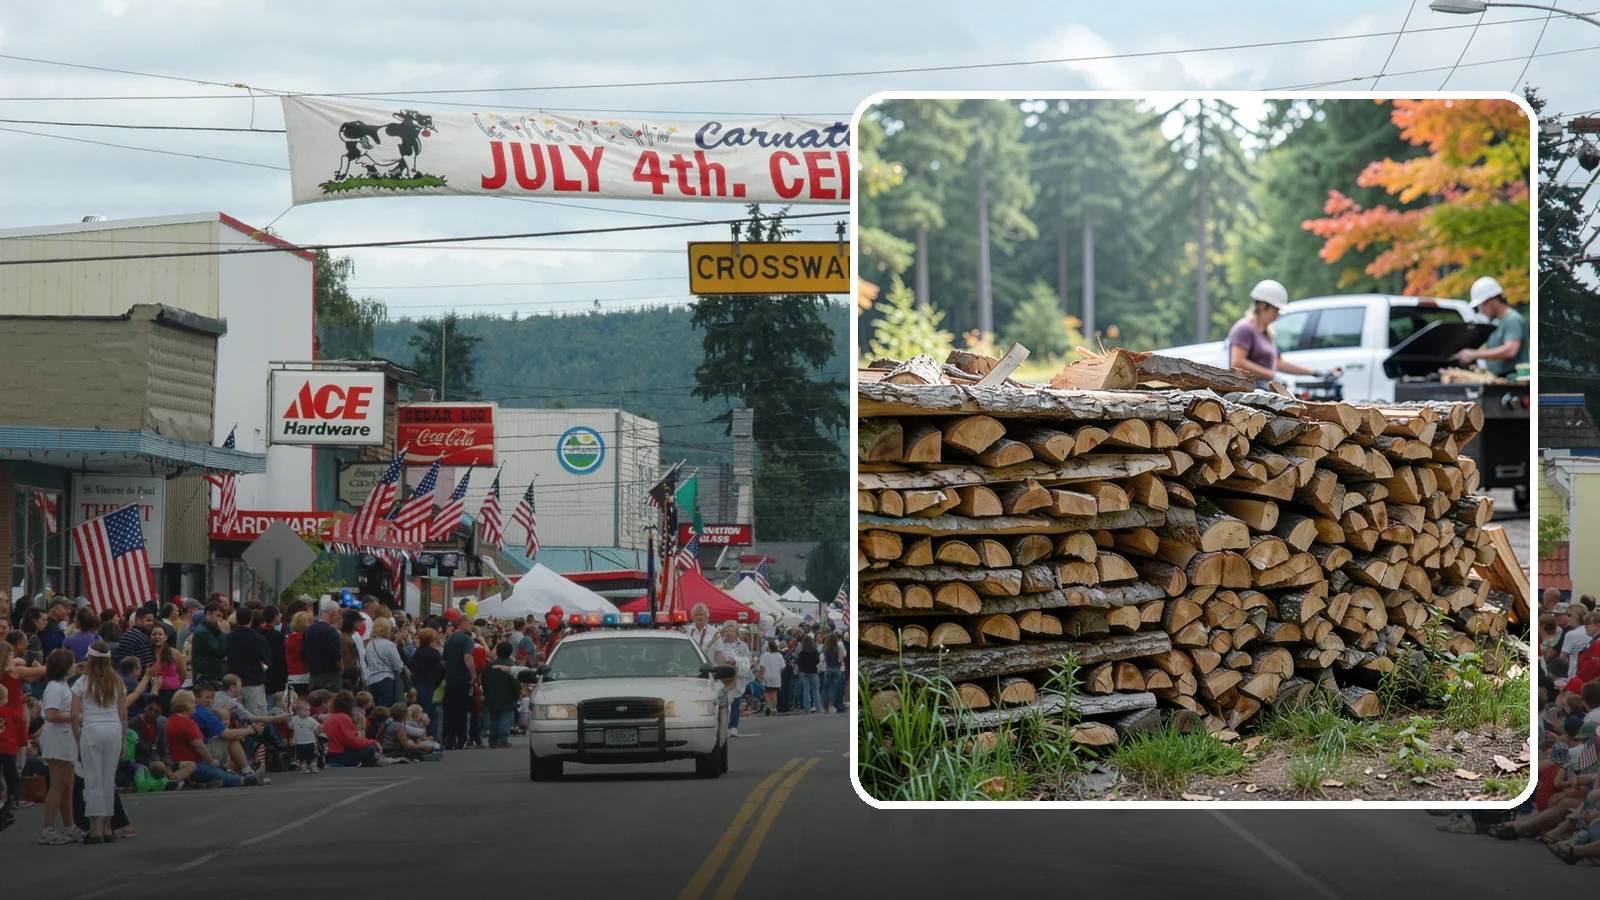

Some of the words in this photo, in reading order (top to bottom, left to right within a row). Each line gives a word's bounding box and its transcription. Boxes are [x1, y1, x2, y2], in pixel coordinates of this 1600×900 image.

[695, 121, 850, 150] Carnat
[481, 141, 605, 193] JULY
[632, 150, 746, 198] 4th.
[696, 254, 850, 280] CROSSWA
[282, 380, 373, 420] ACE
[405, 409, 453, 422] CEDAR
[461, 409, 485, 421] LOG
[283, 421, 371, 437] Hardware
[416, 428, 477, 447] Coca-Cola
[83, 485, 94, 495] St.
[95, 485, 124, 495] Vincent
[126, 485, 136, 495] de
[137, 485, 155, 496] Paul
[687, 526, 742, 535] CRNATION
[698, 535, 731, 543] GLASS
